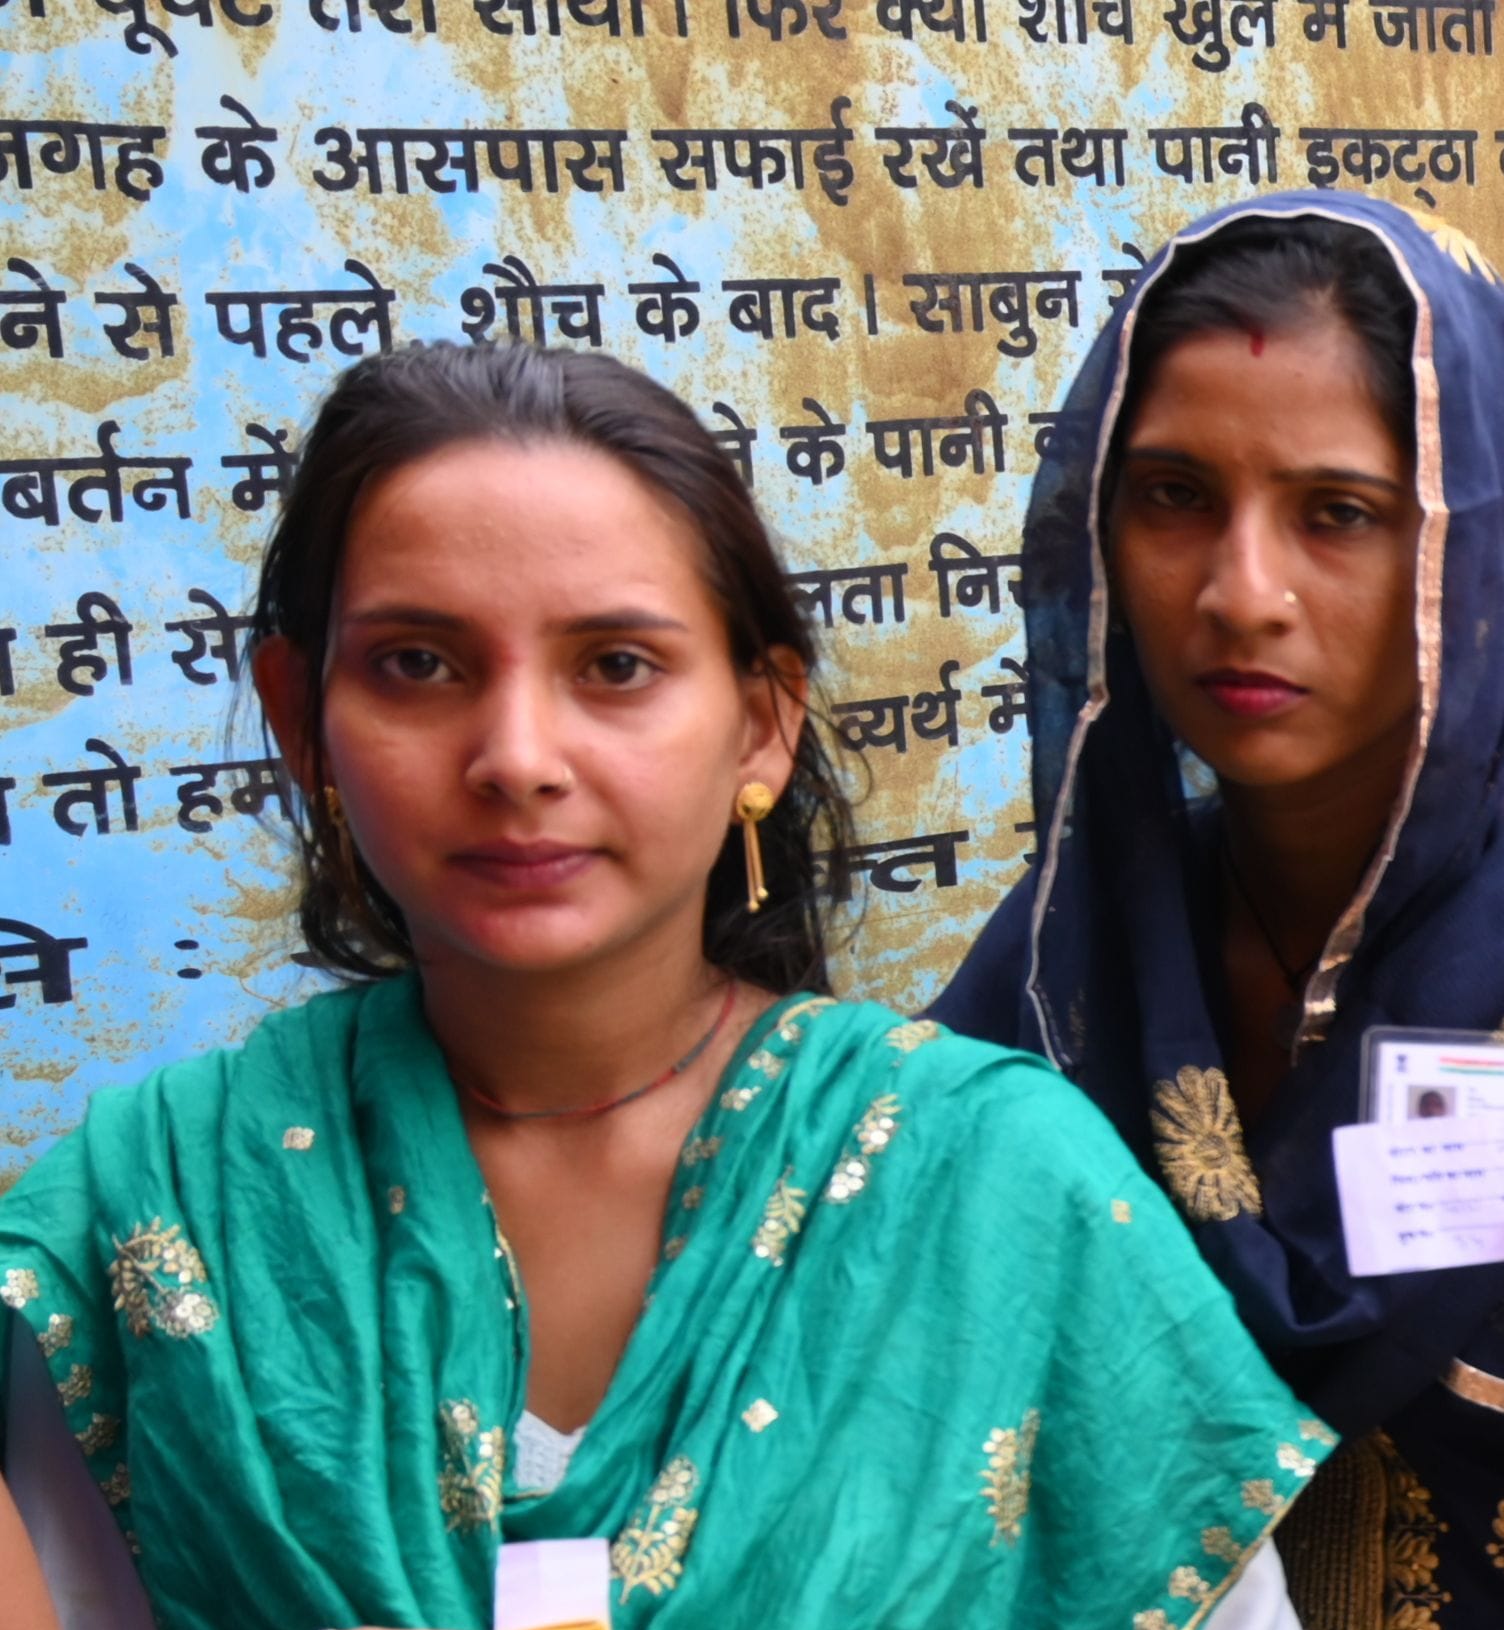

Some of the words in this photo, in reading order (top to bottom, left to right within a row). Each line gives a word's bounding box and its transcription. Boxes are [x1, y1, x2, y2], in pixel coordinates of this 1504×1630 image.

[195, 95, 277, 192] के
[312, 127, 628, 195] आसपास
[650, 96, 854, 207] सफाई
[874, 102, 987, 189] रखें
[1007, 127, 1128, 187] तथा
[1147, 102, 1281, 185] पानी
[94, 262, 178, 361] से
[205, 256, 396, 361] पहले
[460, 255, 604, 348] शौच
[628, 253, 700, 342] के
[902, 271, 1081, 358] साबुन
[0, 420, 192, 526] बर्तन
[220, 420, 298, 512] में
[779, 397, 846, 485] के
[865, 390, 1008, 479] पानी
[44, 592, 133, 696] ही
[166, 588, 256, 684] से
[41, 739, 142, 832] तो
[829, 659, 962, 754] व्यर्थ
